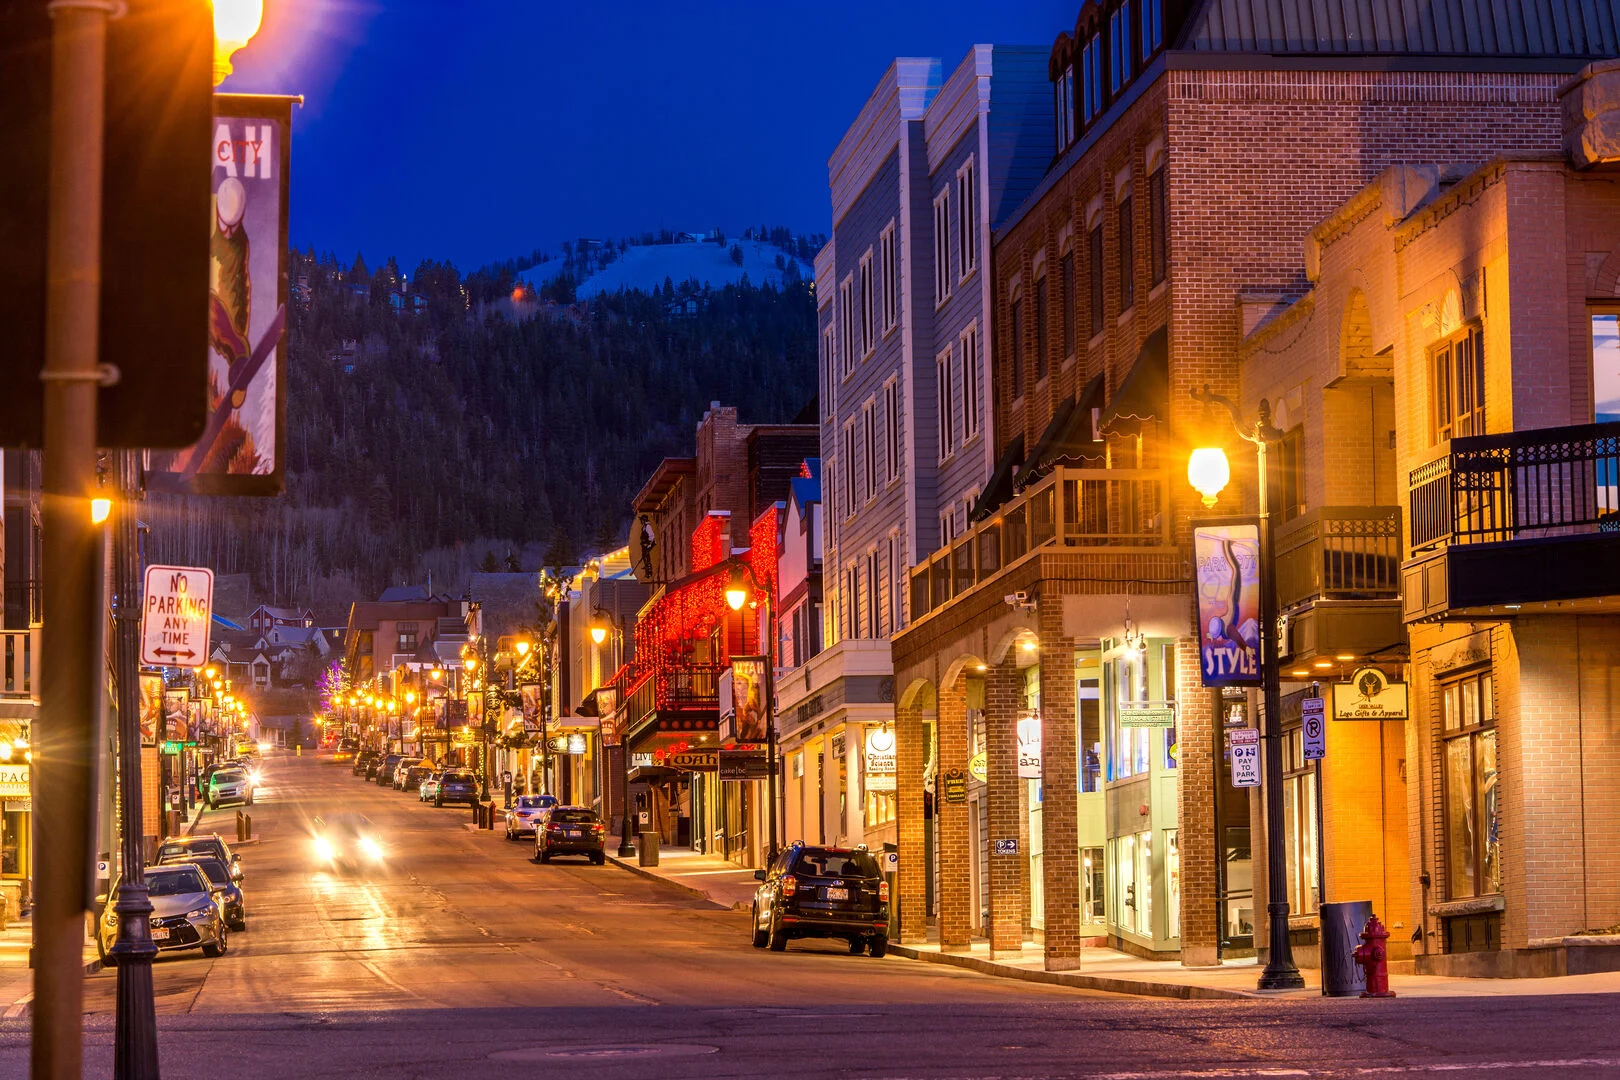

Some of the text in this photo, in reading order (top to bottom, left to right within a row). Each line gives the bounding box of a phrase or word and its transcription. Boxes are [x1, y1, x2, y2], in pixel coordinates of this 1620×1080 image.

[217, 140, 263, 164] CITY
[1200, 556, 1227, 573] PARK
[170, 574, 188, 594] NO
[149, 595, 205, 616] PARKING
[164, 617, 188, 630] ANY
[162, 631, 189, 645] TIME
[735, 661, 764, 674] UTAH
[1206, 647, 1257, 676] STYLE
[1355, 709, 1370, 717] Gifts
[1379, 709, 1404, 717] Apparel
